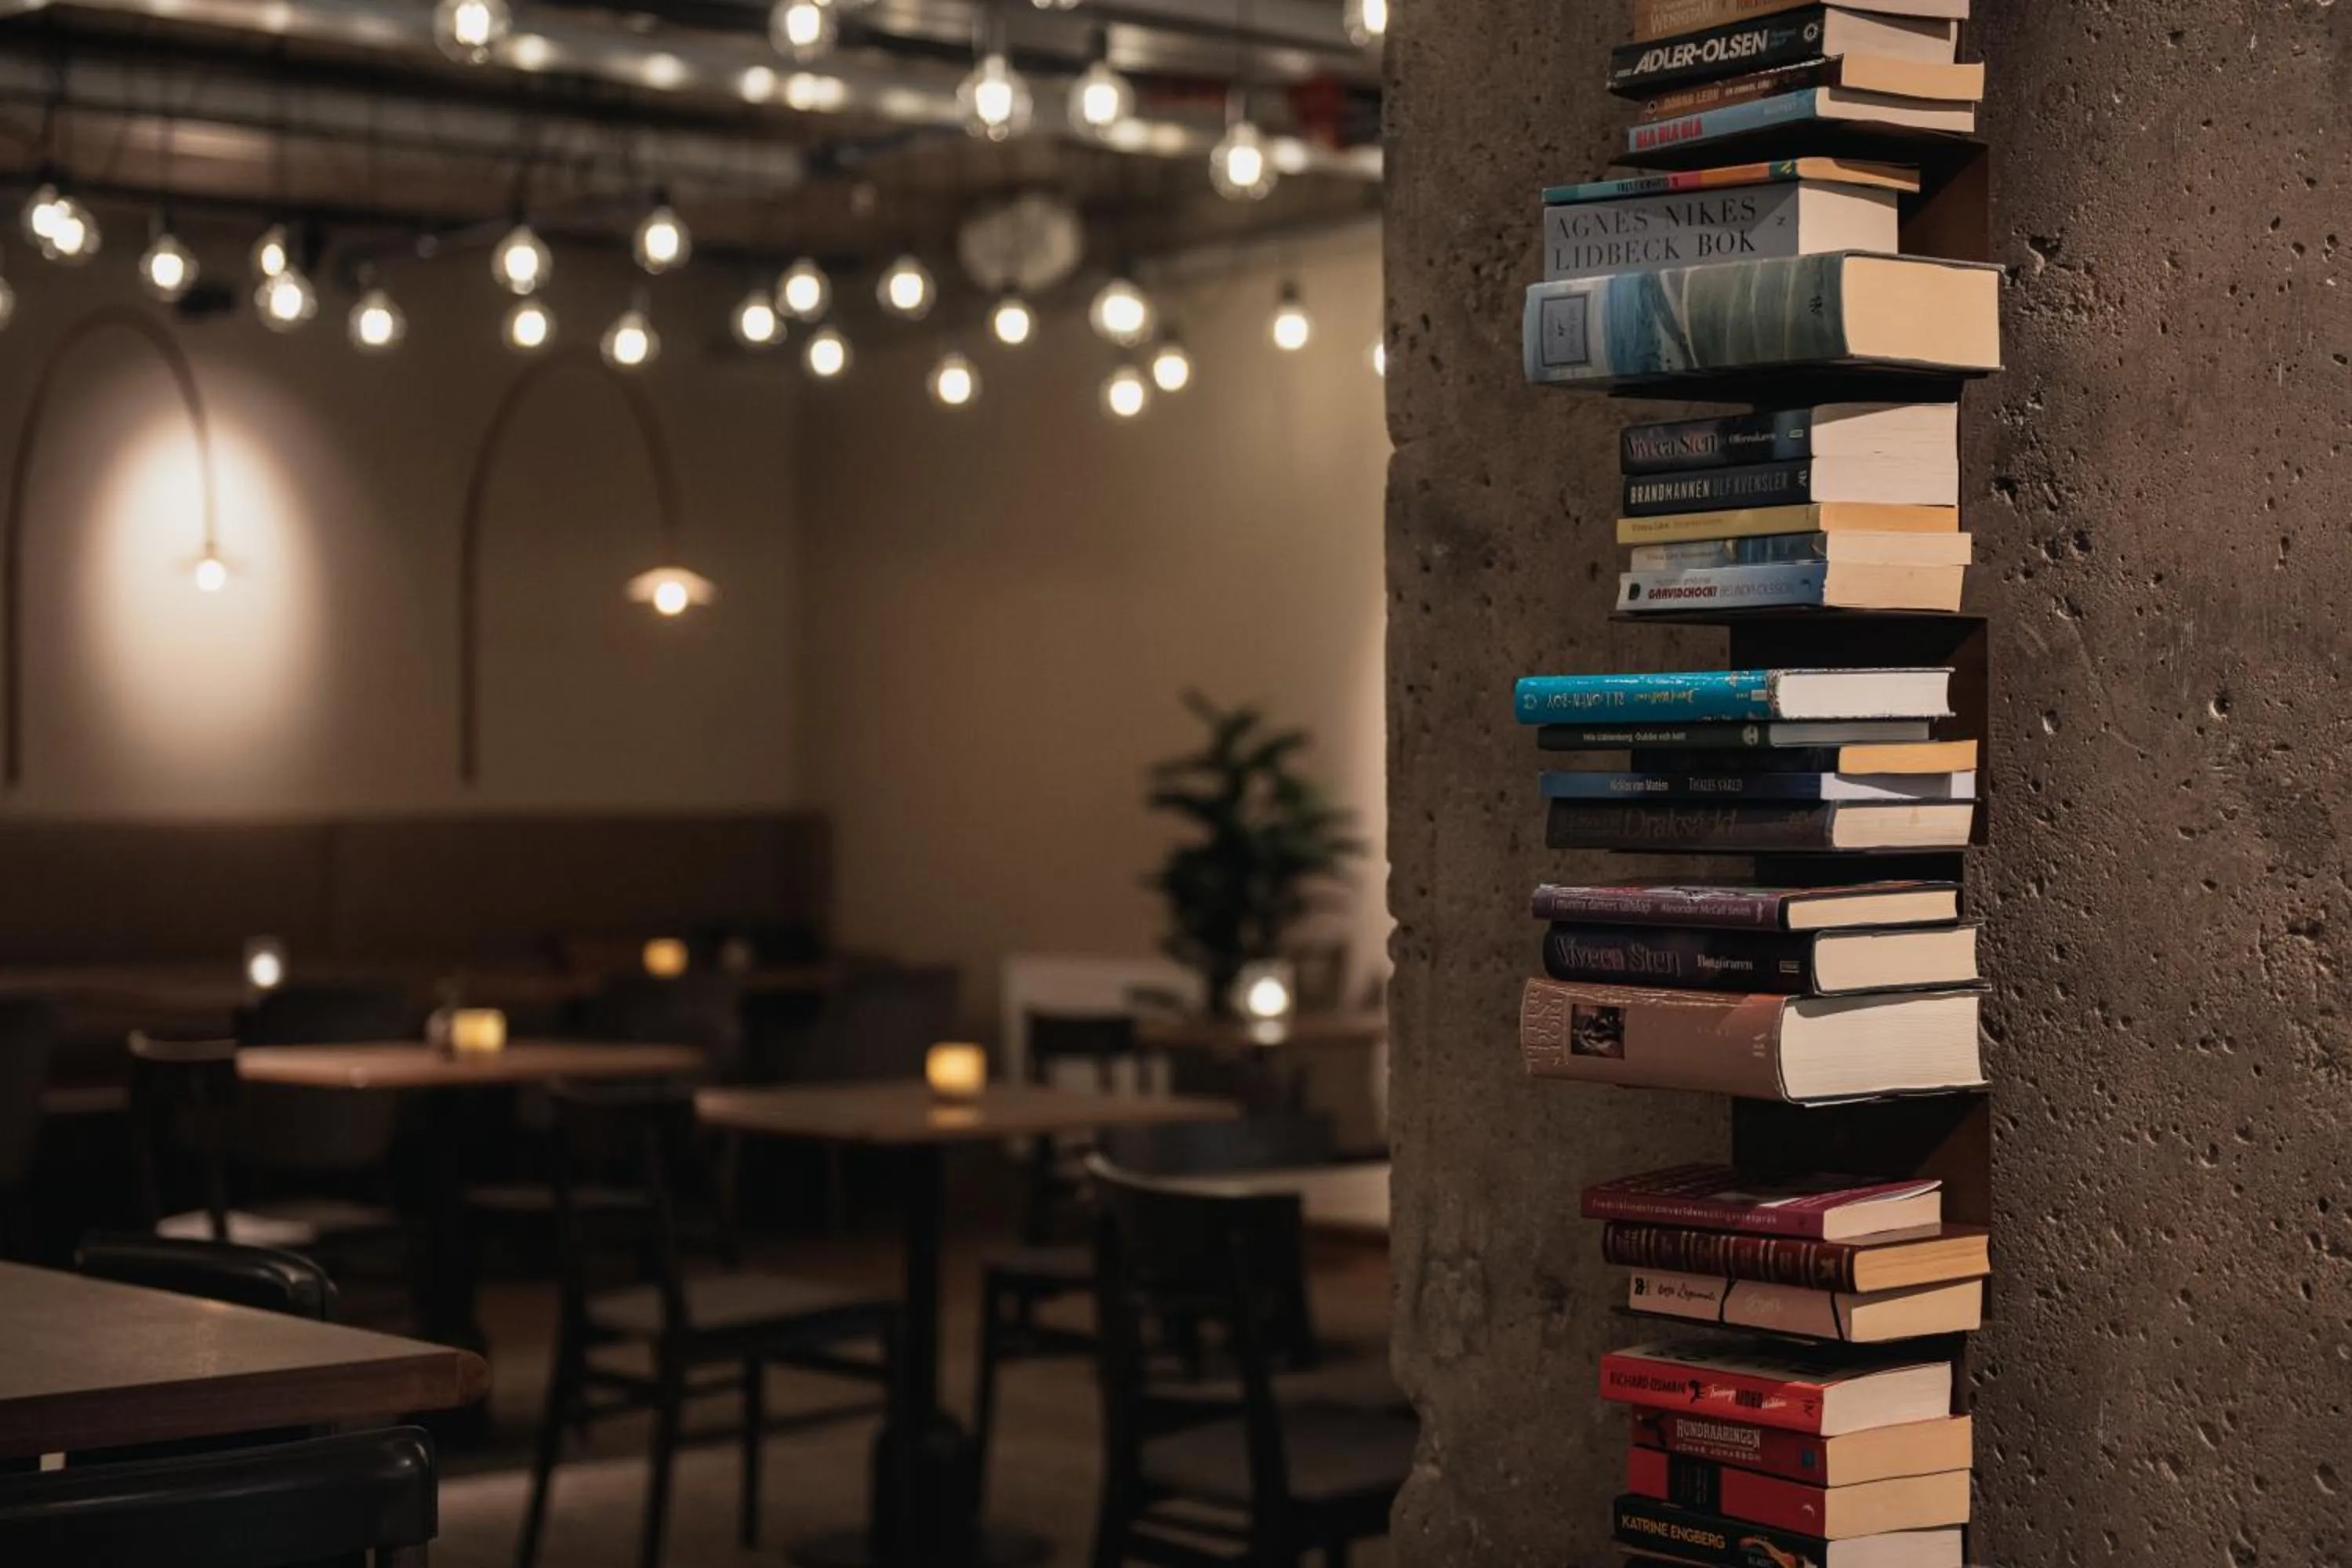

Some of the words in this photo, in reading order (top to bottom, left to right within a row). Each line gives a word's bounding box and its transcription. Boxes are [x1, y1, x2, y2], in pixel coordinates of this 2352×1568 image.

[1633, 30, 1767, 74] ADLER-OLSEN
[1557, 207, 1648, 240] AGNES
[1665, 196, 1756, 227] NIKES
[1555, 236, 1680, 271] LIDBECK
[1697, 229, 1756, 257] BOK
[1626, 435, 1676, 458] Viveca
[1679, 433, 1718, 456] Sten
[1630, 479, 1710, 504] BRANDMANNEN
[1712, 477, 1730, 497] ULF
[1555, 935, 1625, 971] Viveca
[1628, 942, 1680, 977] Sten
[1610, 1371, 1648, 1390] RICHARD
[1650, 1377, 1687, 1394] OSMAN
[1621, 1514, 1669, 1538] KATRINE
[1671, 1523, 1726, 1549] ENGBERG
